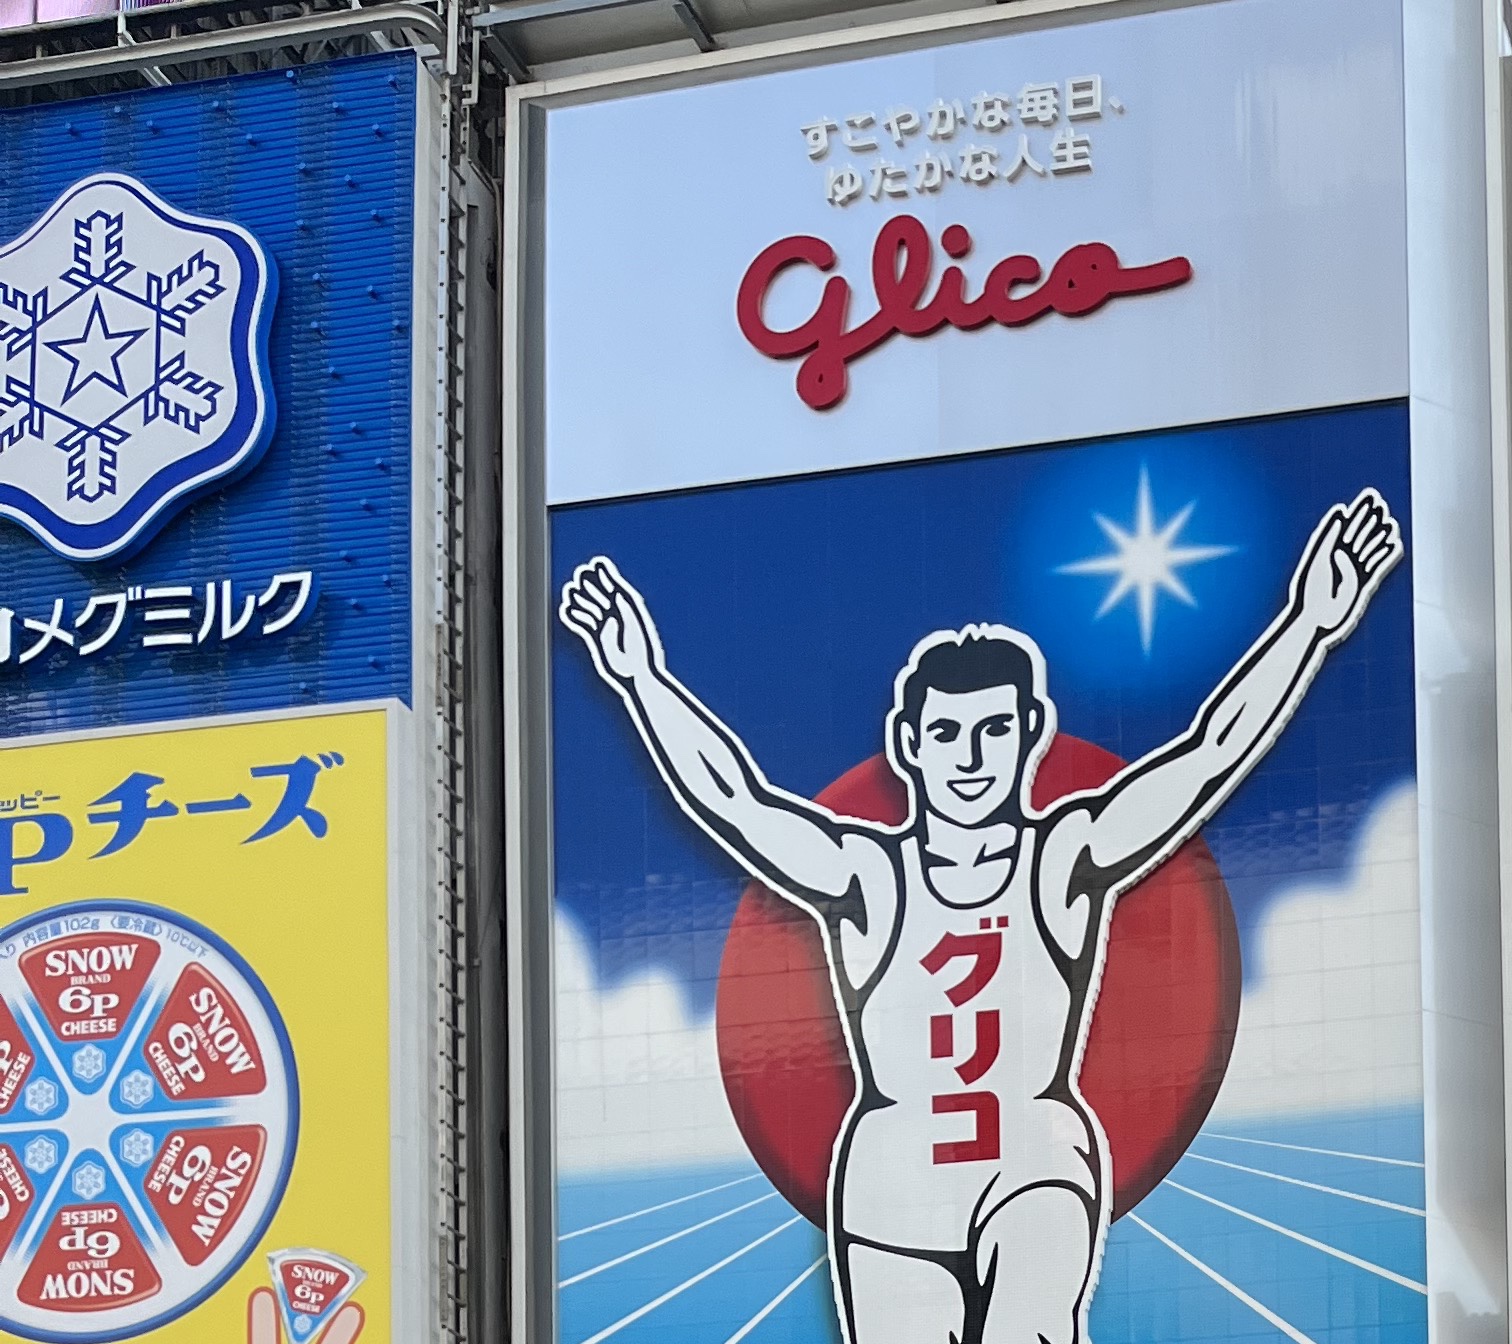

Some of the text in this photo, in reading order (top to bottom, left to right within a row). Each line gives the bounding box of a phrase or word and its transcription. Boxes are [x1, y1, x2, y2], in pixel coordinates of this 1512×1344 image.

[800, 74, 1124, 161] すこやかな毎日、
[827, 127, 1092, 206] ゆたかな人生
[737, 214, 1193, 411] Glico
[45, 944, 139, 977] SNOW
[70, 974, 111, 986] BRAND
[61, 1018, 117, 1036] CHEESE
[189, 986, 256, 1077] SNOW
[192, 1023, 219, 1062] BRAND
[919, 916, 1009, 1165] グリコ
[148, 1041, 186, 1097] CHEESE
[148, 1135, 186, 1193] CHEESE
[191, 1145, 252, 1247] SNOW
[192, 1165, 219, 1208] BRAND
[61, 1209, 118, 1225] CHEESE
[39, 1269, 135, 1301] SNOW
[67, 1259, 108, 1270] BRAND
[291, 1265, 340, 1285] SNOW
